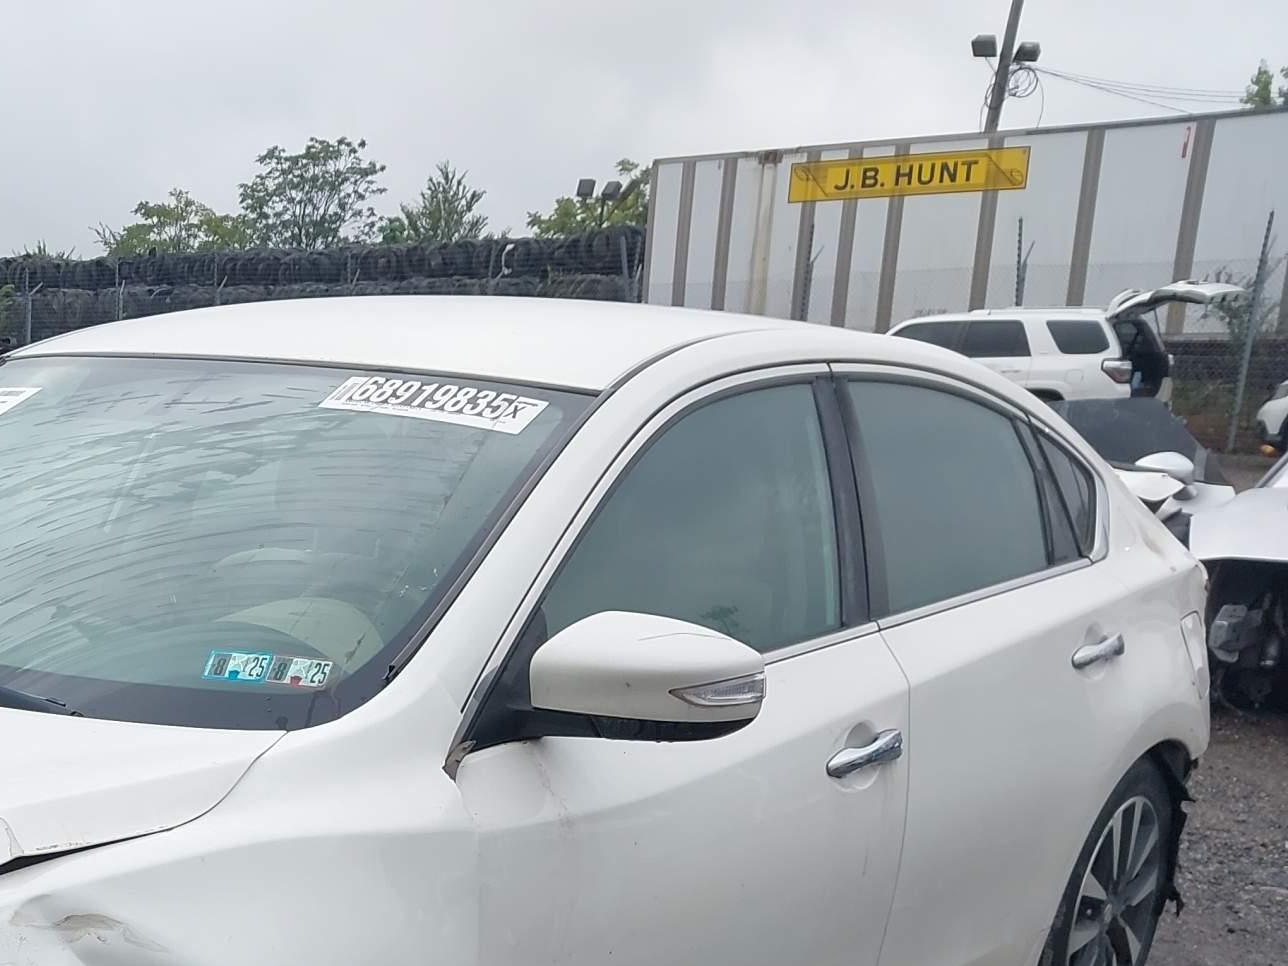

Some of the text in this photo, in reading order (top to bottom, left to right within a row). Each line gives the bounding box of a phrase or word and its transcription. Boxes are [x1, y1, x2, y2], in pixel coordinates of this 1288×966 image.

[833, 159, 980, 191] J.B. HUNT
[247, 656, 268, 678] 25
[309, 661, 330, 684] 25
